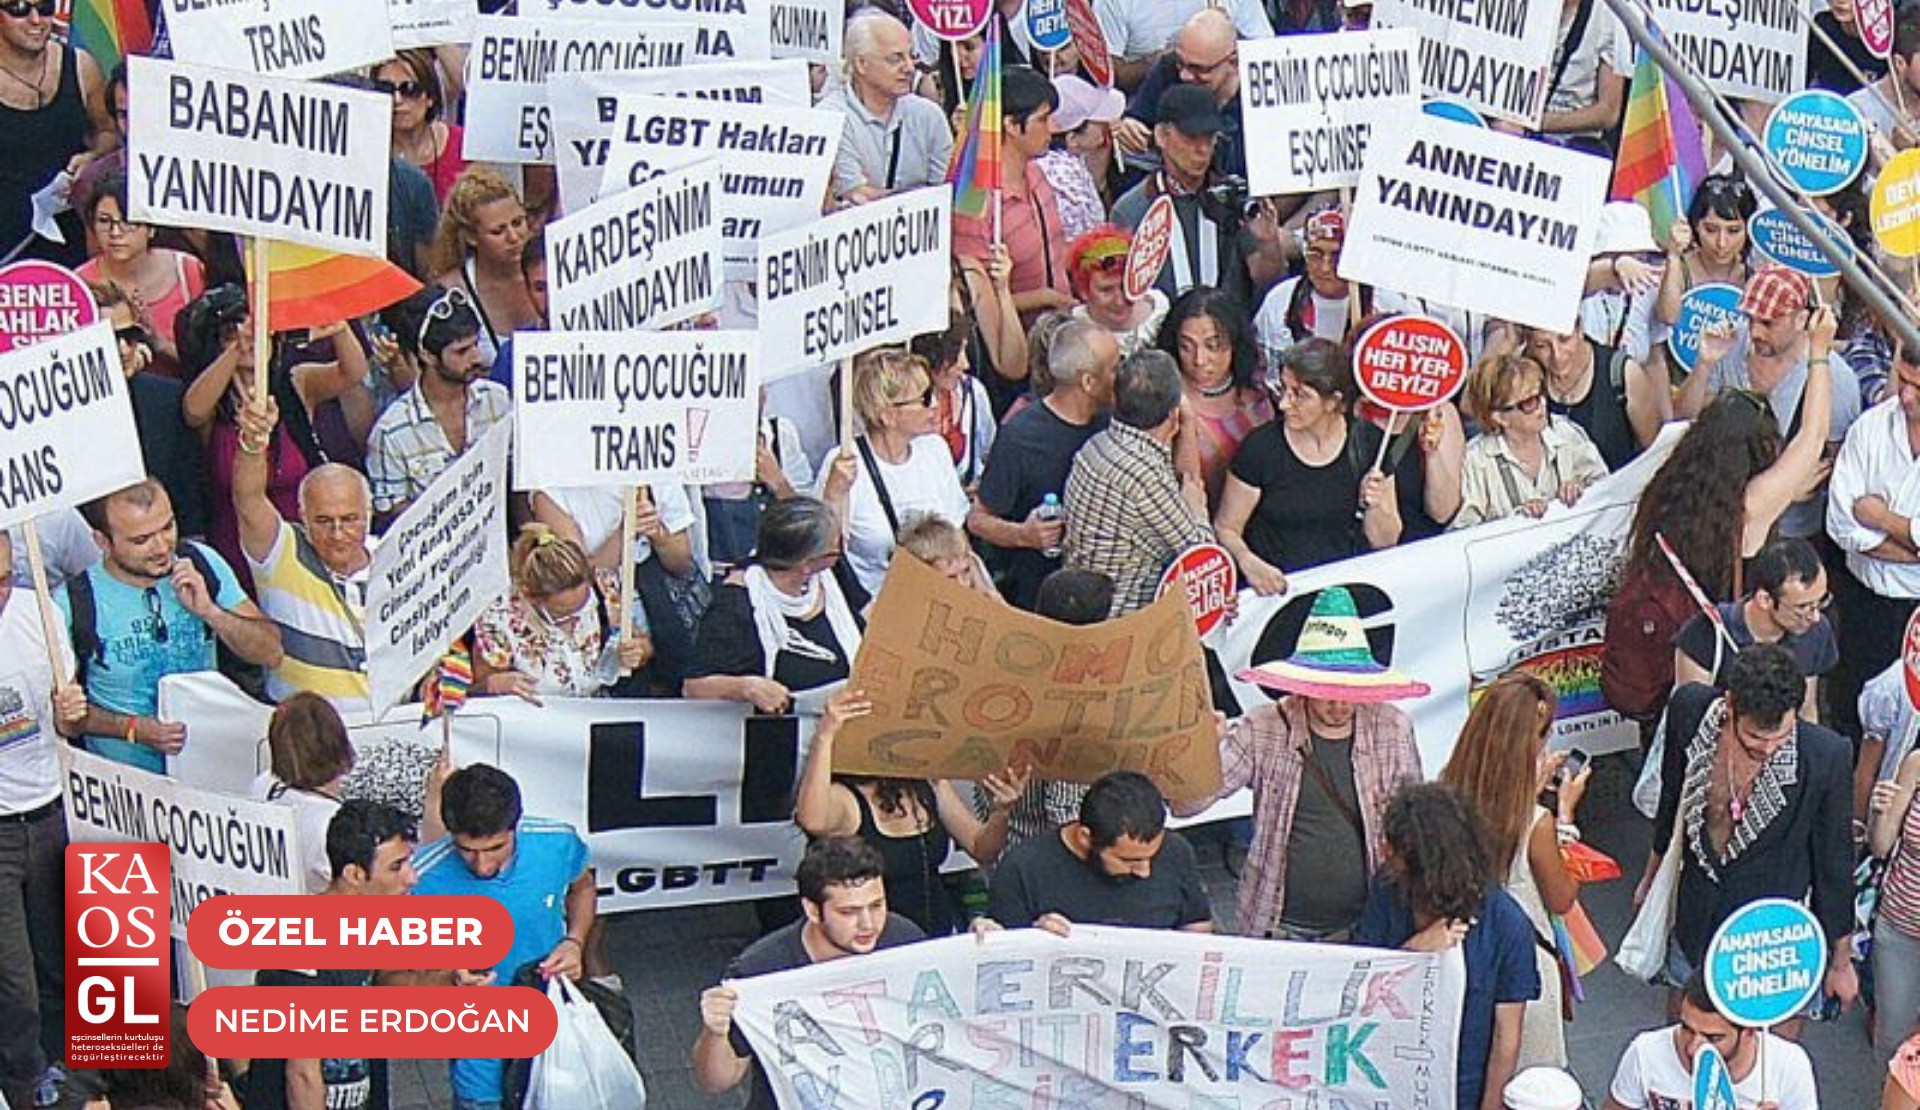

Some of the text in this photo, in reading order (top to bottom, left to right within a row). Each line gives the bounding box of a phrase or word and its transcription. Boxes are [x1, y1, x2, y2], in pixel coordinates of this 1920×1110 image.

[243, 14, 326, 72] TRANS
[480, 29, 557, 84] BENİM
[1248, 42, 1410, 115] BENİM ÇOCUĞUM
[169, 75, 350, 157] BABANIM
[625, 114, 827, 156] LGBT Hakları
[1289, 114, 1371, 187] EŞCİNSE
[1405, 140, 1563, 202] ANNENİM
[138, 153, 374, 241] YANINDAYIM
[555, 176, 713, 289] KARDEŞİNİM
[767, 206, 940, 301] BENİM ÇOCUĞUM
[804, 285, 899, 362] EŞCİNSEL
[1383, 329, 1452, 358] ALIŞIN
[0, 348, 114, 431] OCUĞUM
[524, 342, 748, 414] BENİM ÇOCUĞUM
[1365, 347, 1459, 379] HER YER-
[1370, 370, 1441, 398] DEYİZ!
[0, 444, 63, 509] RANS
[590, 423, 677, 472] TRANS
[69, 769, 150, 843] BENİM
[1716, 923, 1817, 953] ANAYASADA
[1731, 945, 1802, 975] CİNSEL
[1723, 968, 1812, 1001] YÖNELİM
[1113, 1011, 1388, 1088] ERKEK
